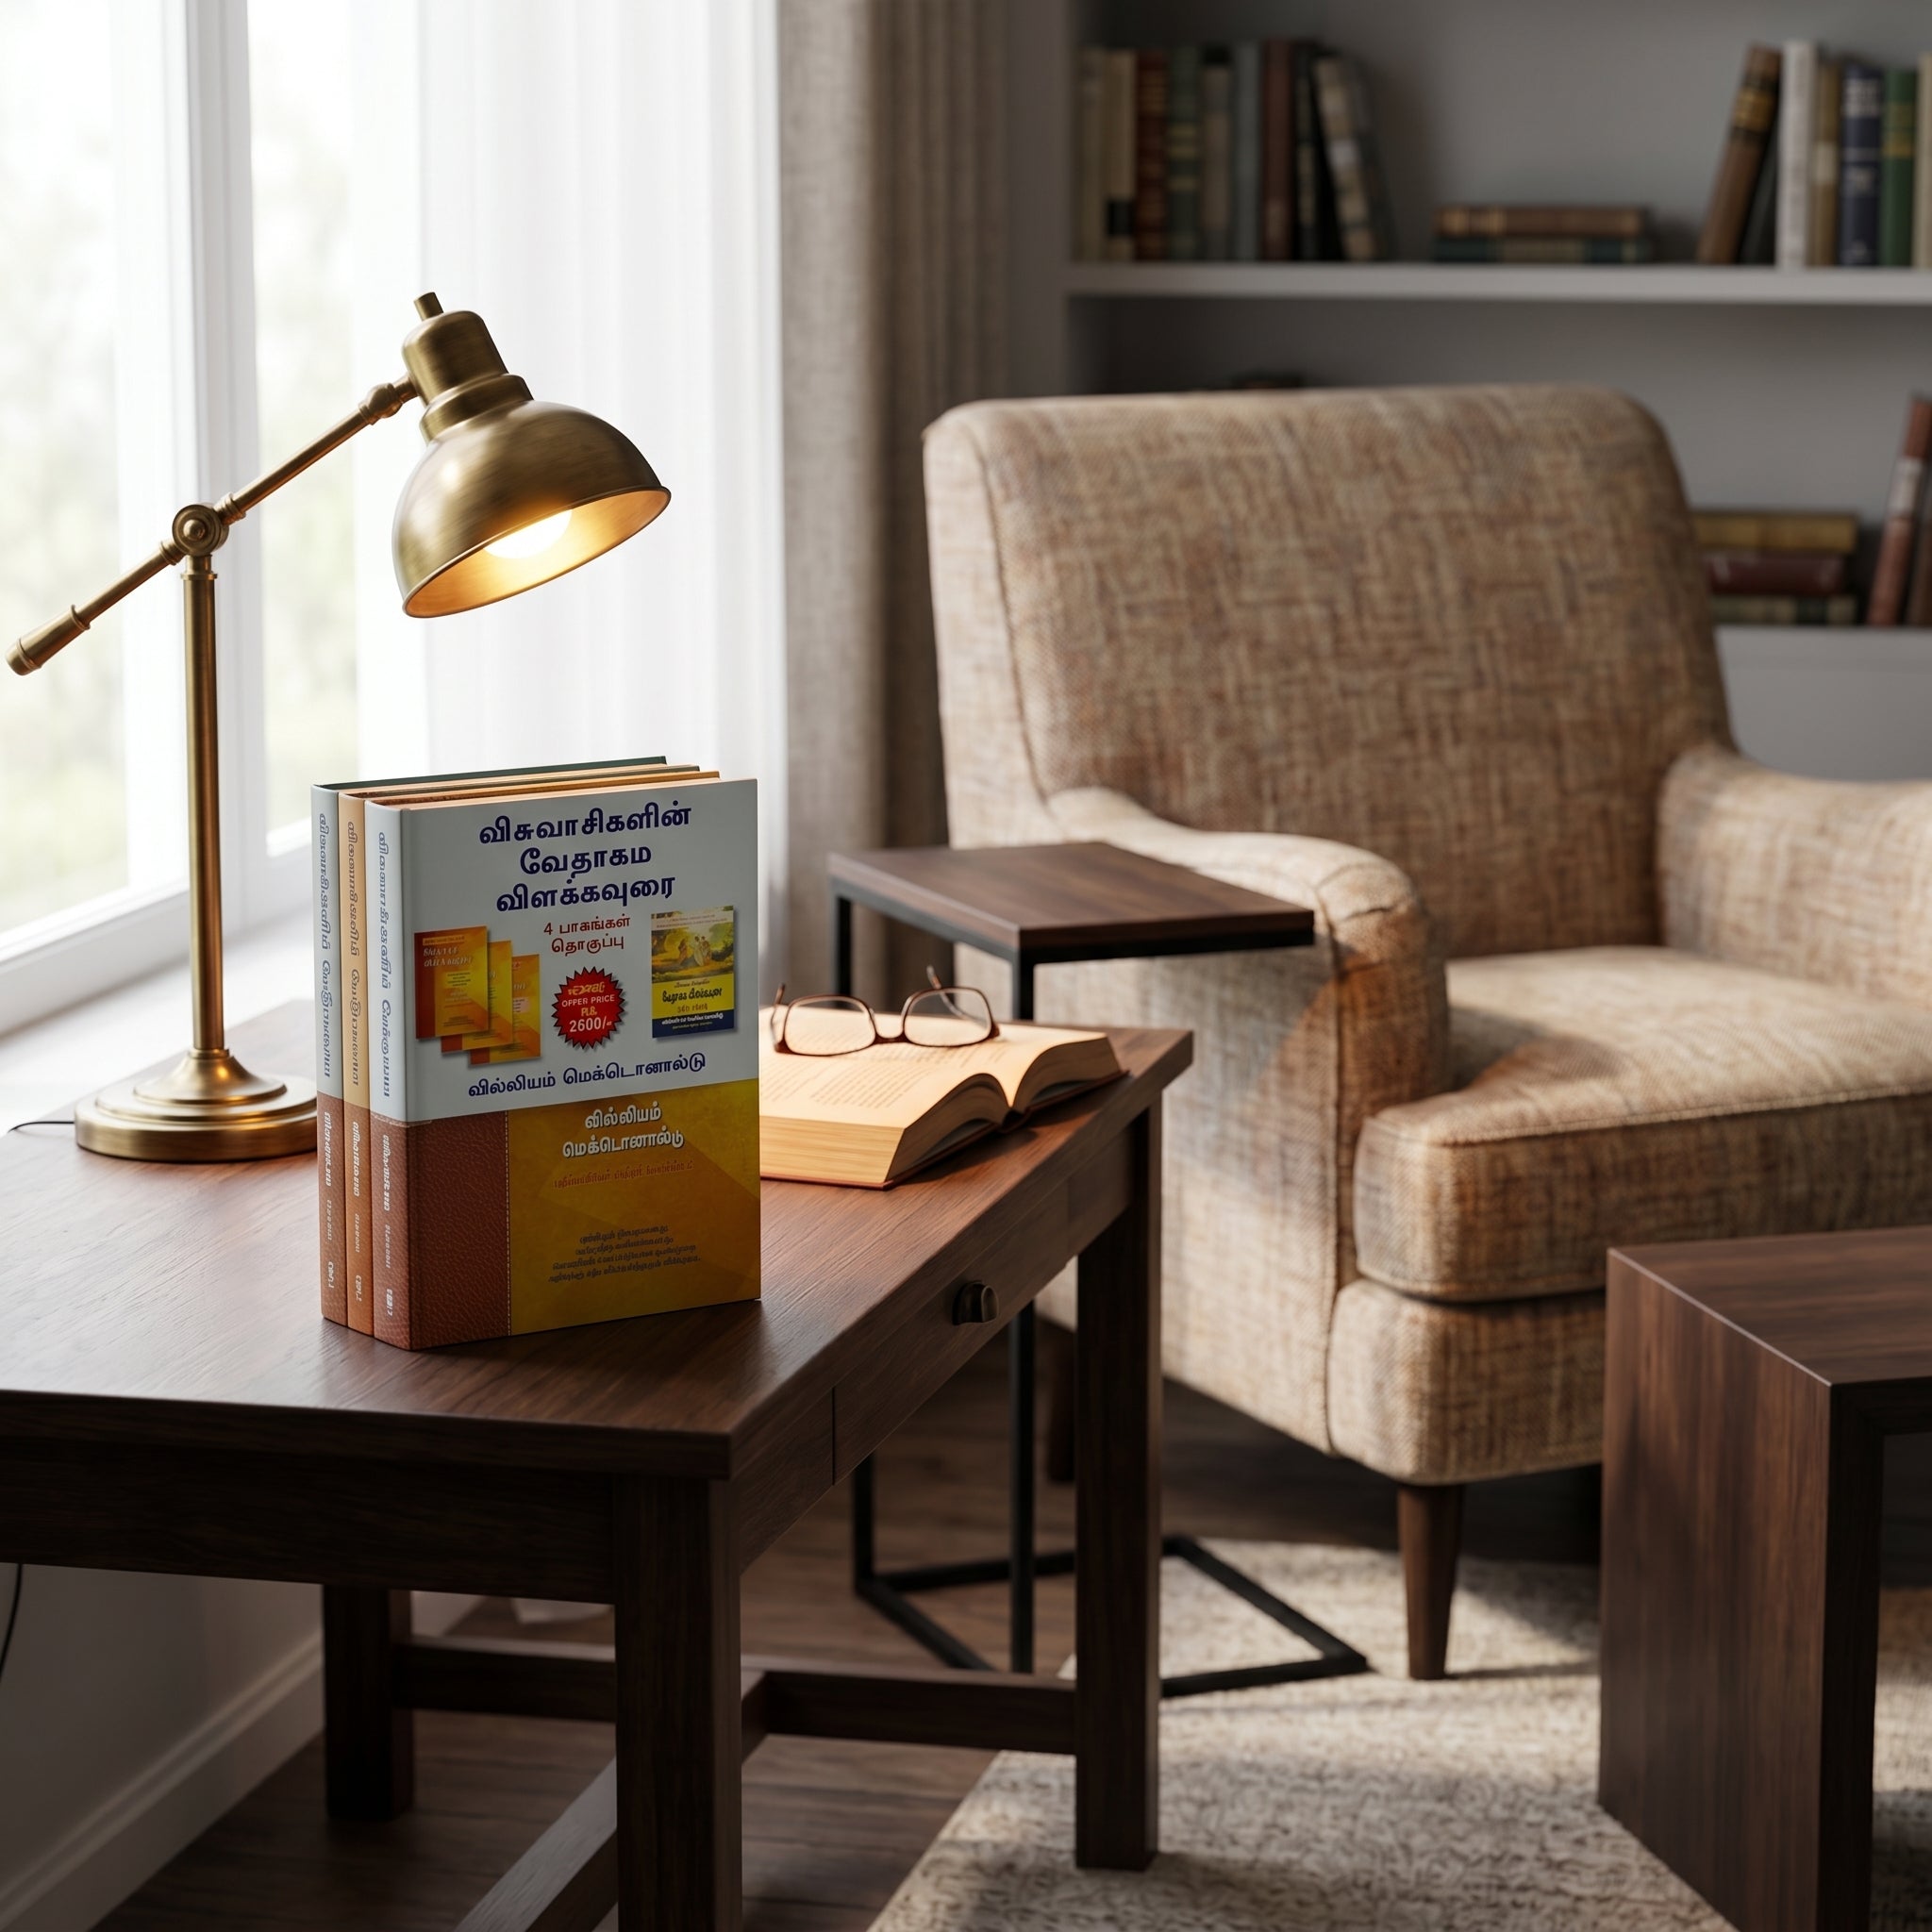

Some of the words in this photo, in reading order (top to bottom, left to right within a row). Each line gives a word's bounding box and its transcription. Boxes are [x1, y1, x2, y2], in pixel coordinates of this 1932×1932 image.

[479, 800, 691, 844] விசுவாசிகளின்
[520, 845, 652, 879] வேதாகம
[496, 876, 675, 912] விளக்கவுரை
[543, 922, 553, 936] 4
[551, 933, 625, 957] தொகுப்பு
[591, 994, 615, 1004] PRICE
[468, 1072, 556, 1097] வில்லியம்
[585, 1100, 661, 1129] வில்லியம்
